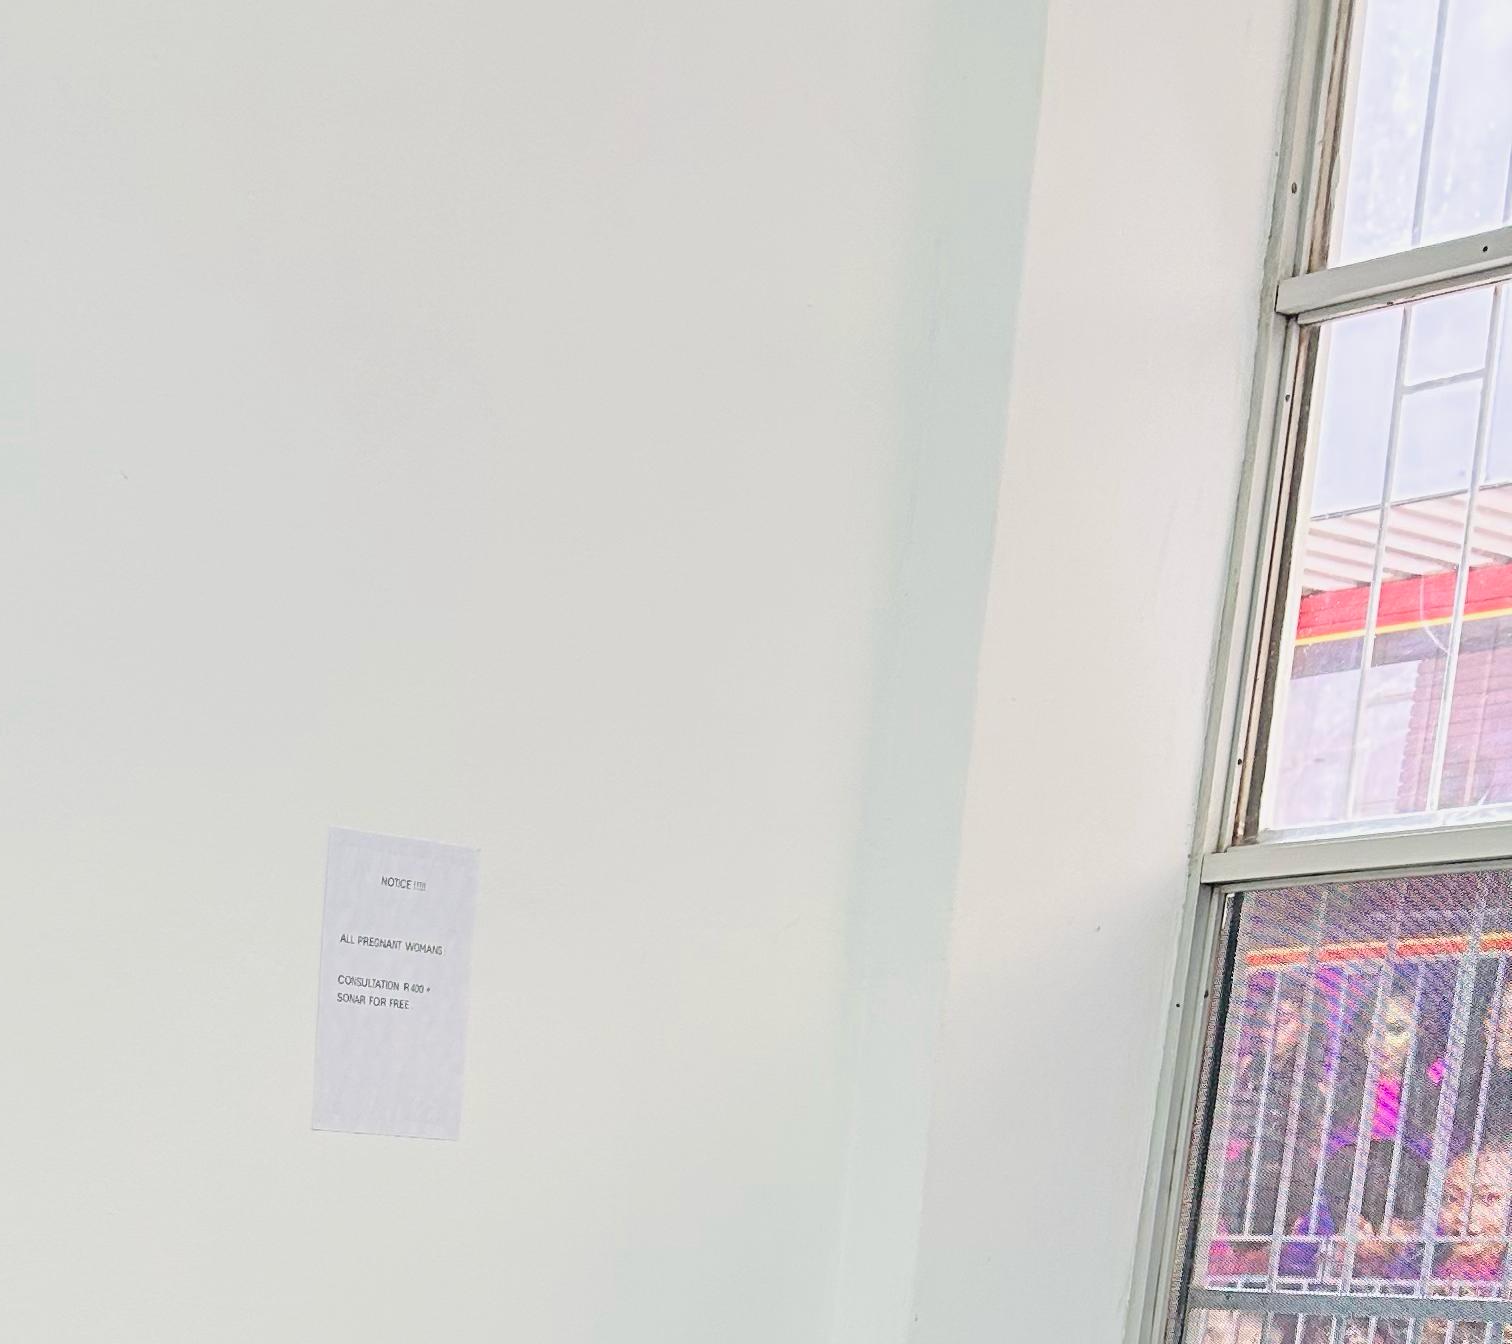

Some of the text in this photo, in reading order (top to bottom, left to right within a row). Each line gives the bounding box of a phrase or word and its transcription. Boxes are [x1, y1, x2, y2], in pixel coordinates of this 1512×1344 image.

[381, 876, 412, 890] NOTICE
[340, 934, 442, 955] ALL PREGNANT WOMANS
[338, 975, 399, 991] CONSULTATION
[337, 993, 365, 1004] SONAR
[369, 996, 386, 1006] FOR
